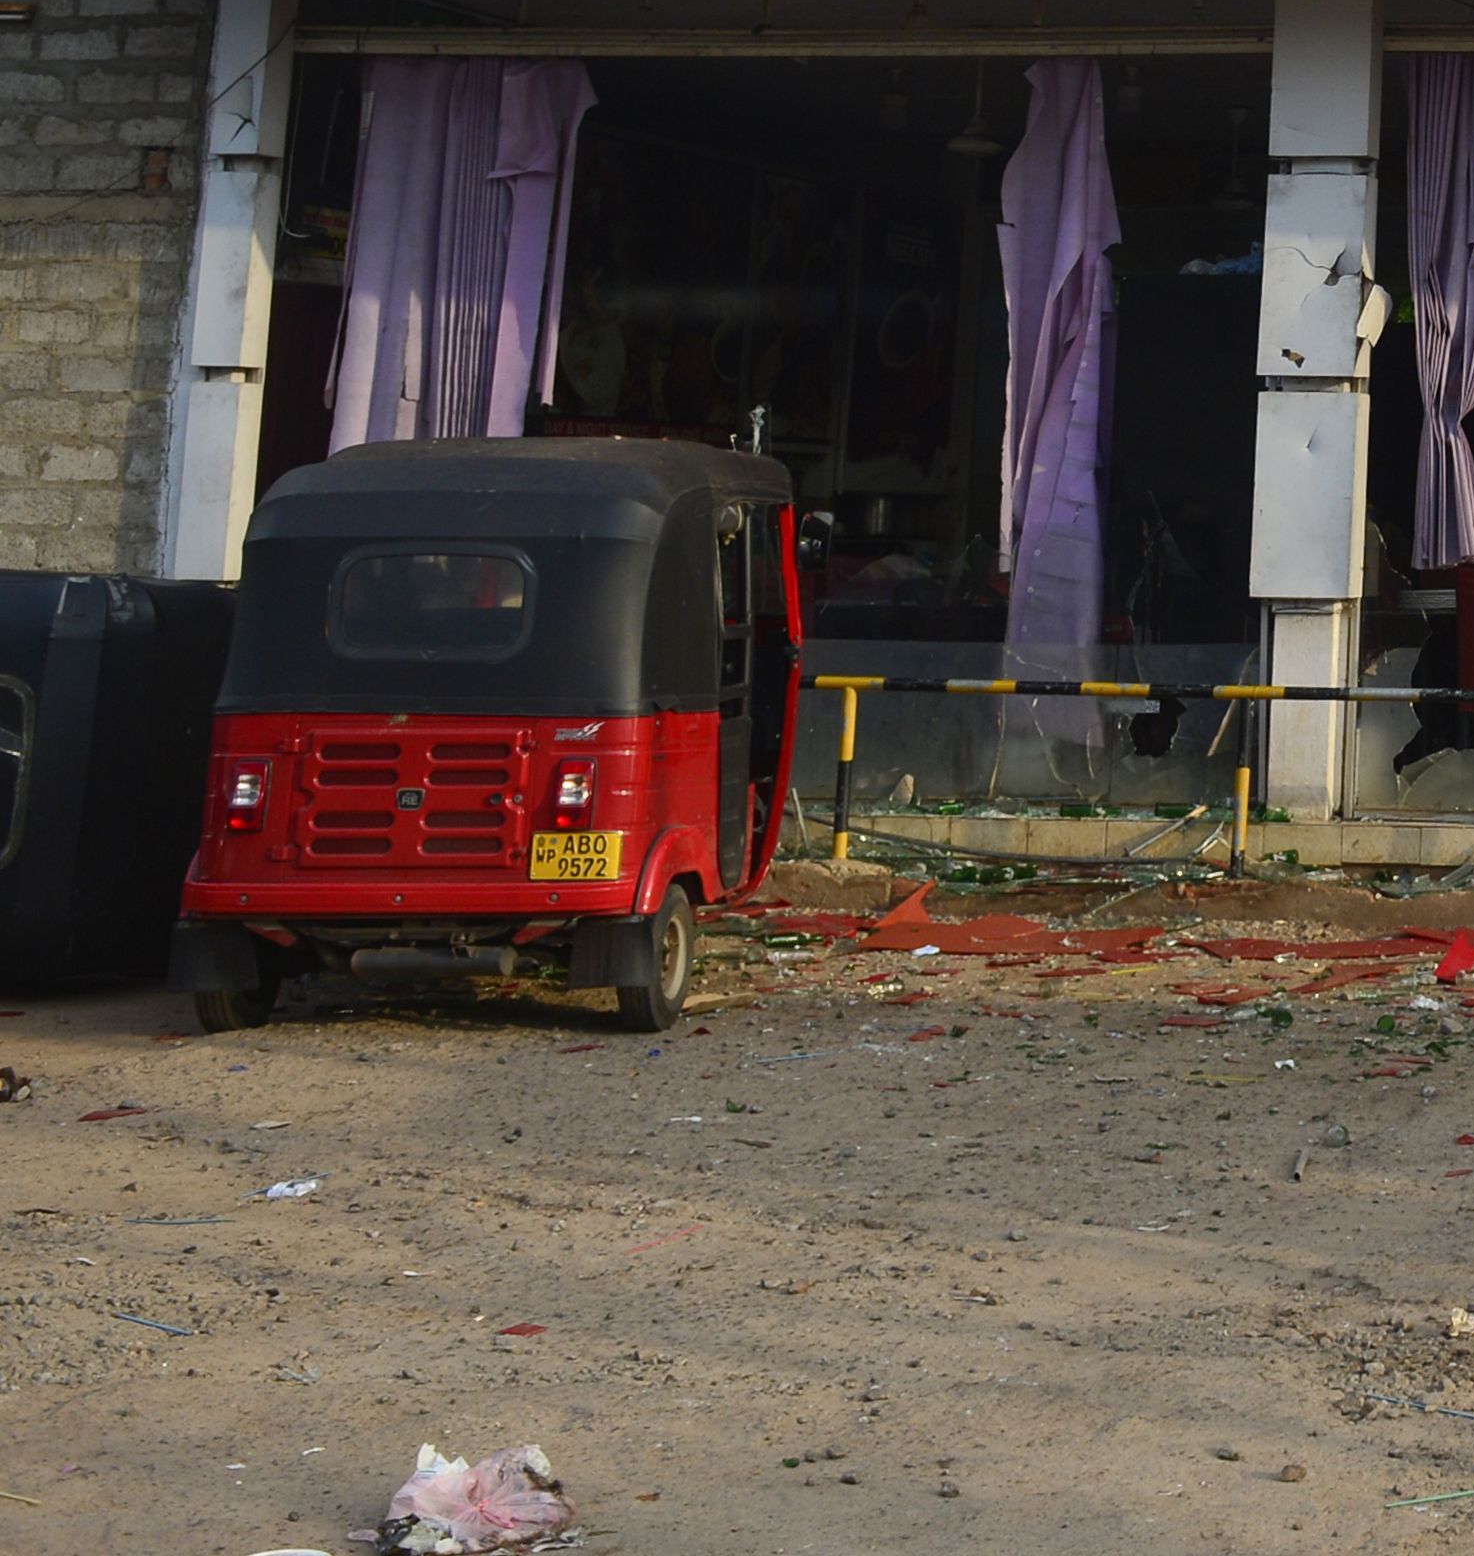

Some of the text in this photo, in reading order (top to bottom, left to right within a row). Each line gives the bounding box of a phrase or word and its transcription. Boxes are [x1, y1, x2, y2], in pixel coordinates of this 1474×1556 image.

[563, 835, 607, 855] ABO
[536, 849, 556, 863] WP
[558, 857, 607, 877] 9572
